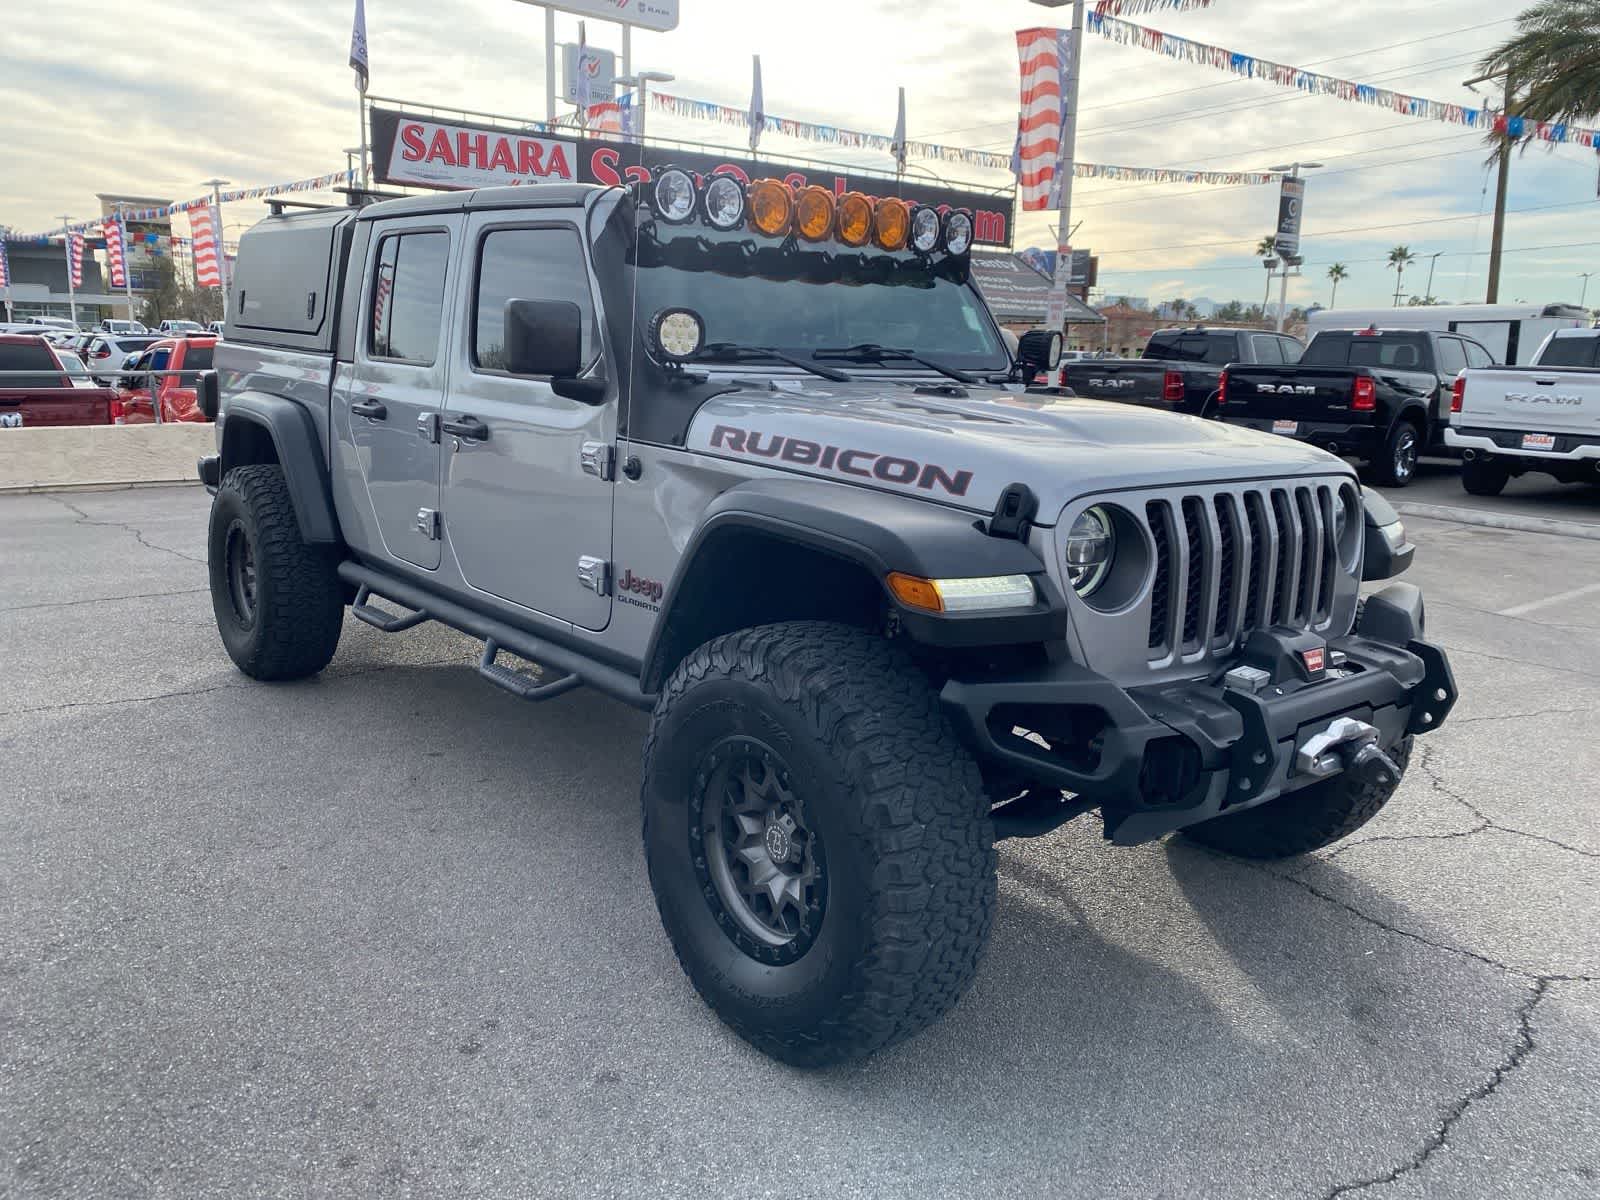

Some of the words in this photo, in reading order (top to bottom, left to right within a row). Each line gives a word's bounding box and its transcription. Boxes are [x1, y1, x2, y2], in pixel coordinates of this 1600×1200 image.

[401, 124, 573, 180] SAHARA
[1088, 378, 1136, 389] RAM
[1256, 383, 1316, 395] RAM
[1504, 392, 1583, 407] RAM
[709, 424, 975, 497] RUBICON
[618, 567, 663, 603] Jeep
